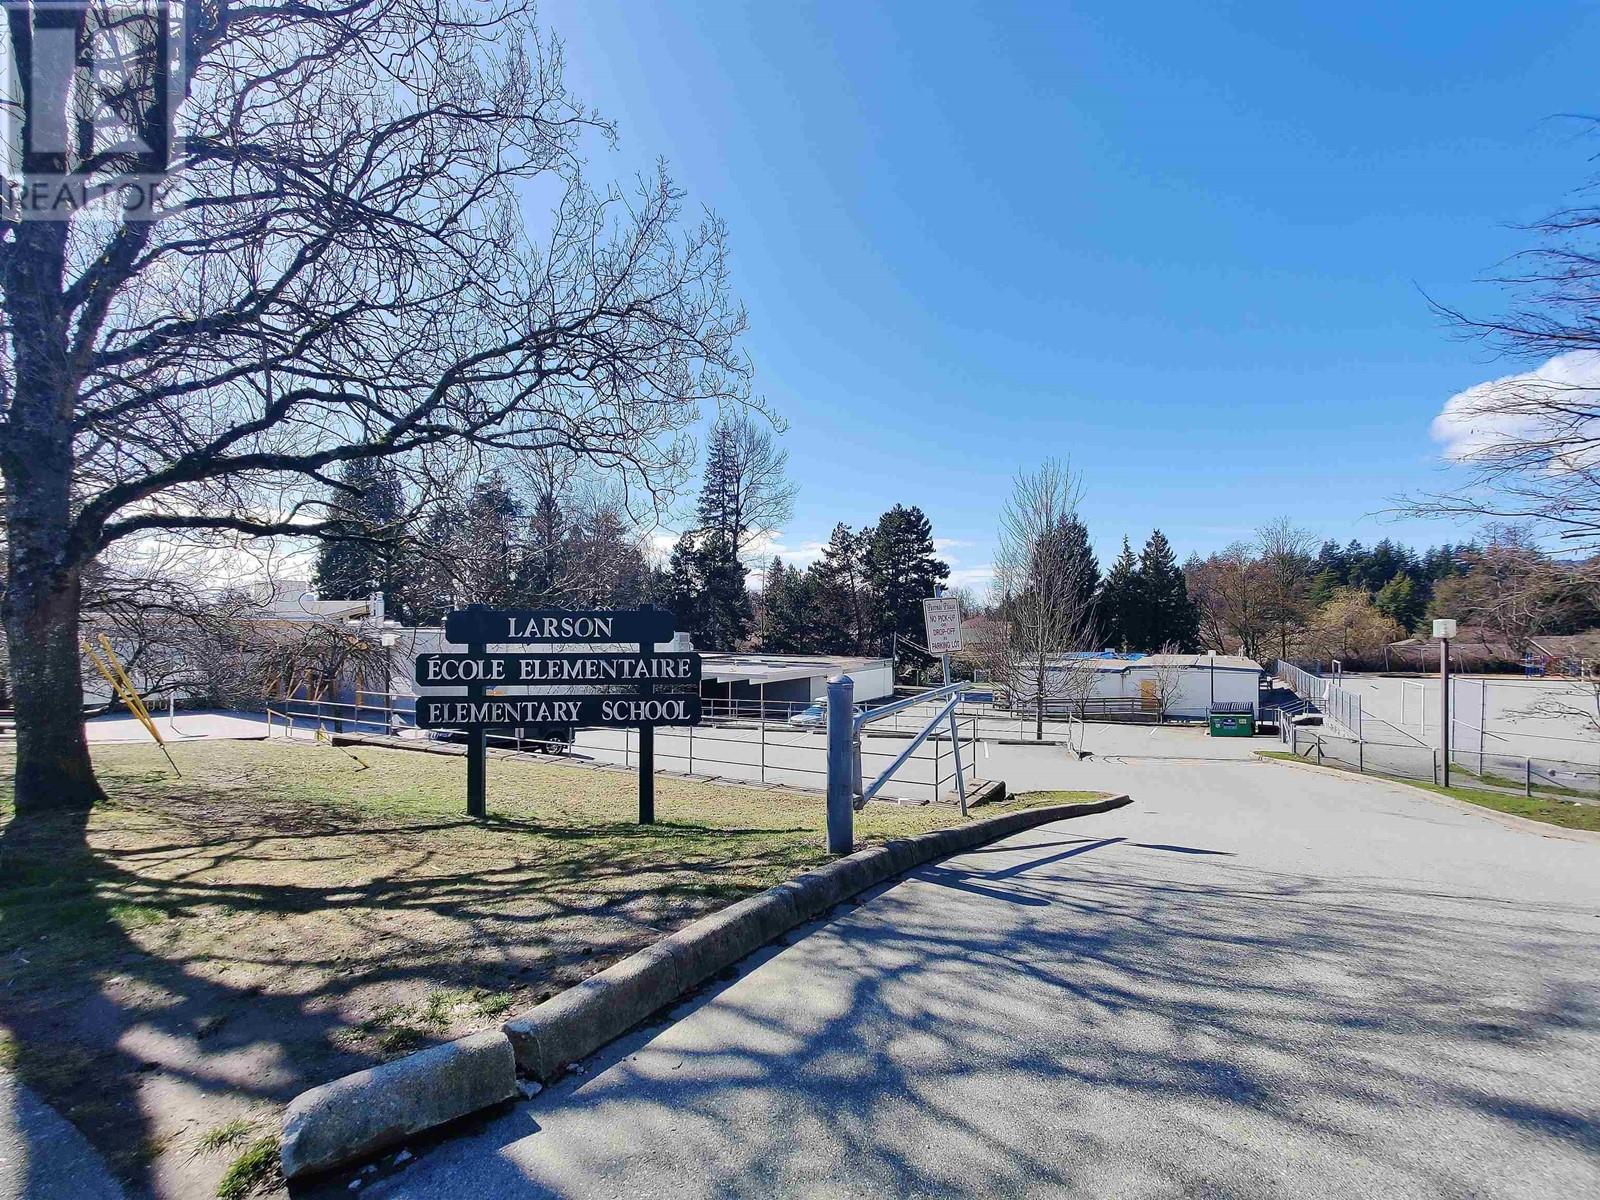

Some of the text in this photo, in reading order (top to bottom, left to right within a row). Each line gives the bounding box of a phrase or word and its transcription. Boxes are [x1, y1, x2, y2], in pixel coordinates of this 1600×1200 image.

[508, 617, 613, 638] LARSON
[933, 628, 955, 636] DROP-OFF
[427, 655, 691, 680] ÉCOLE ELEMENTAIRE
[428, 700, 690, 723] ELEMENTARY SCHOOL
